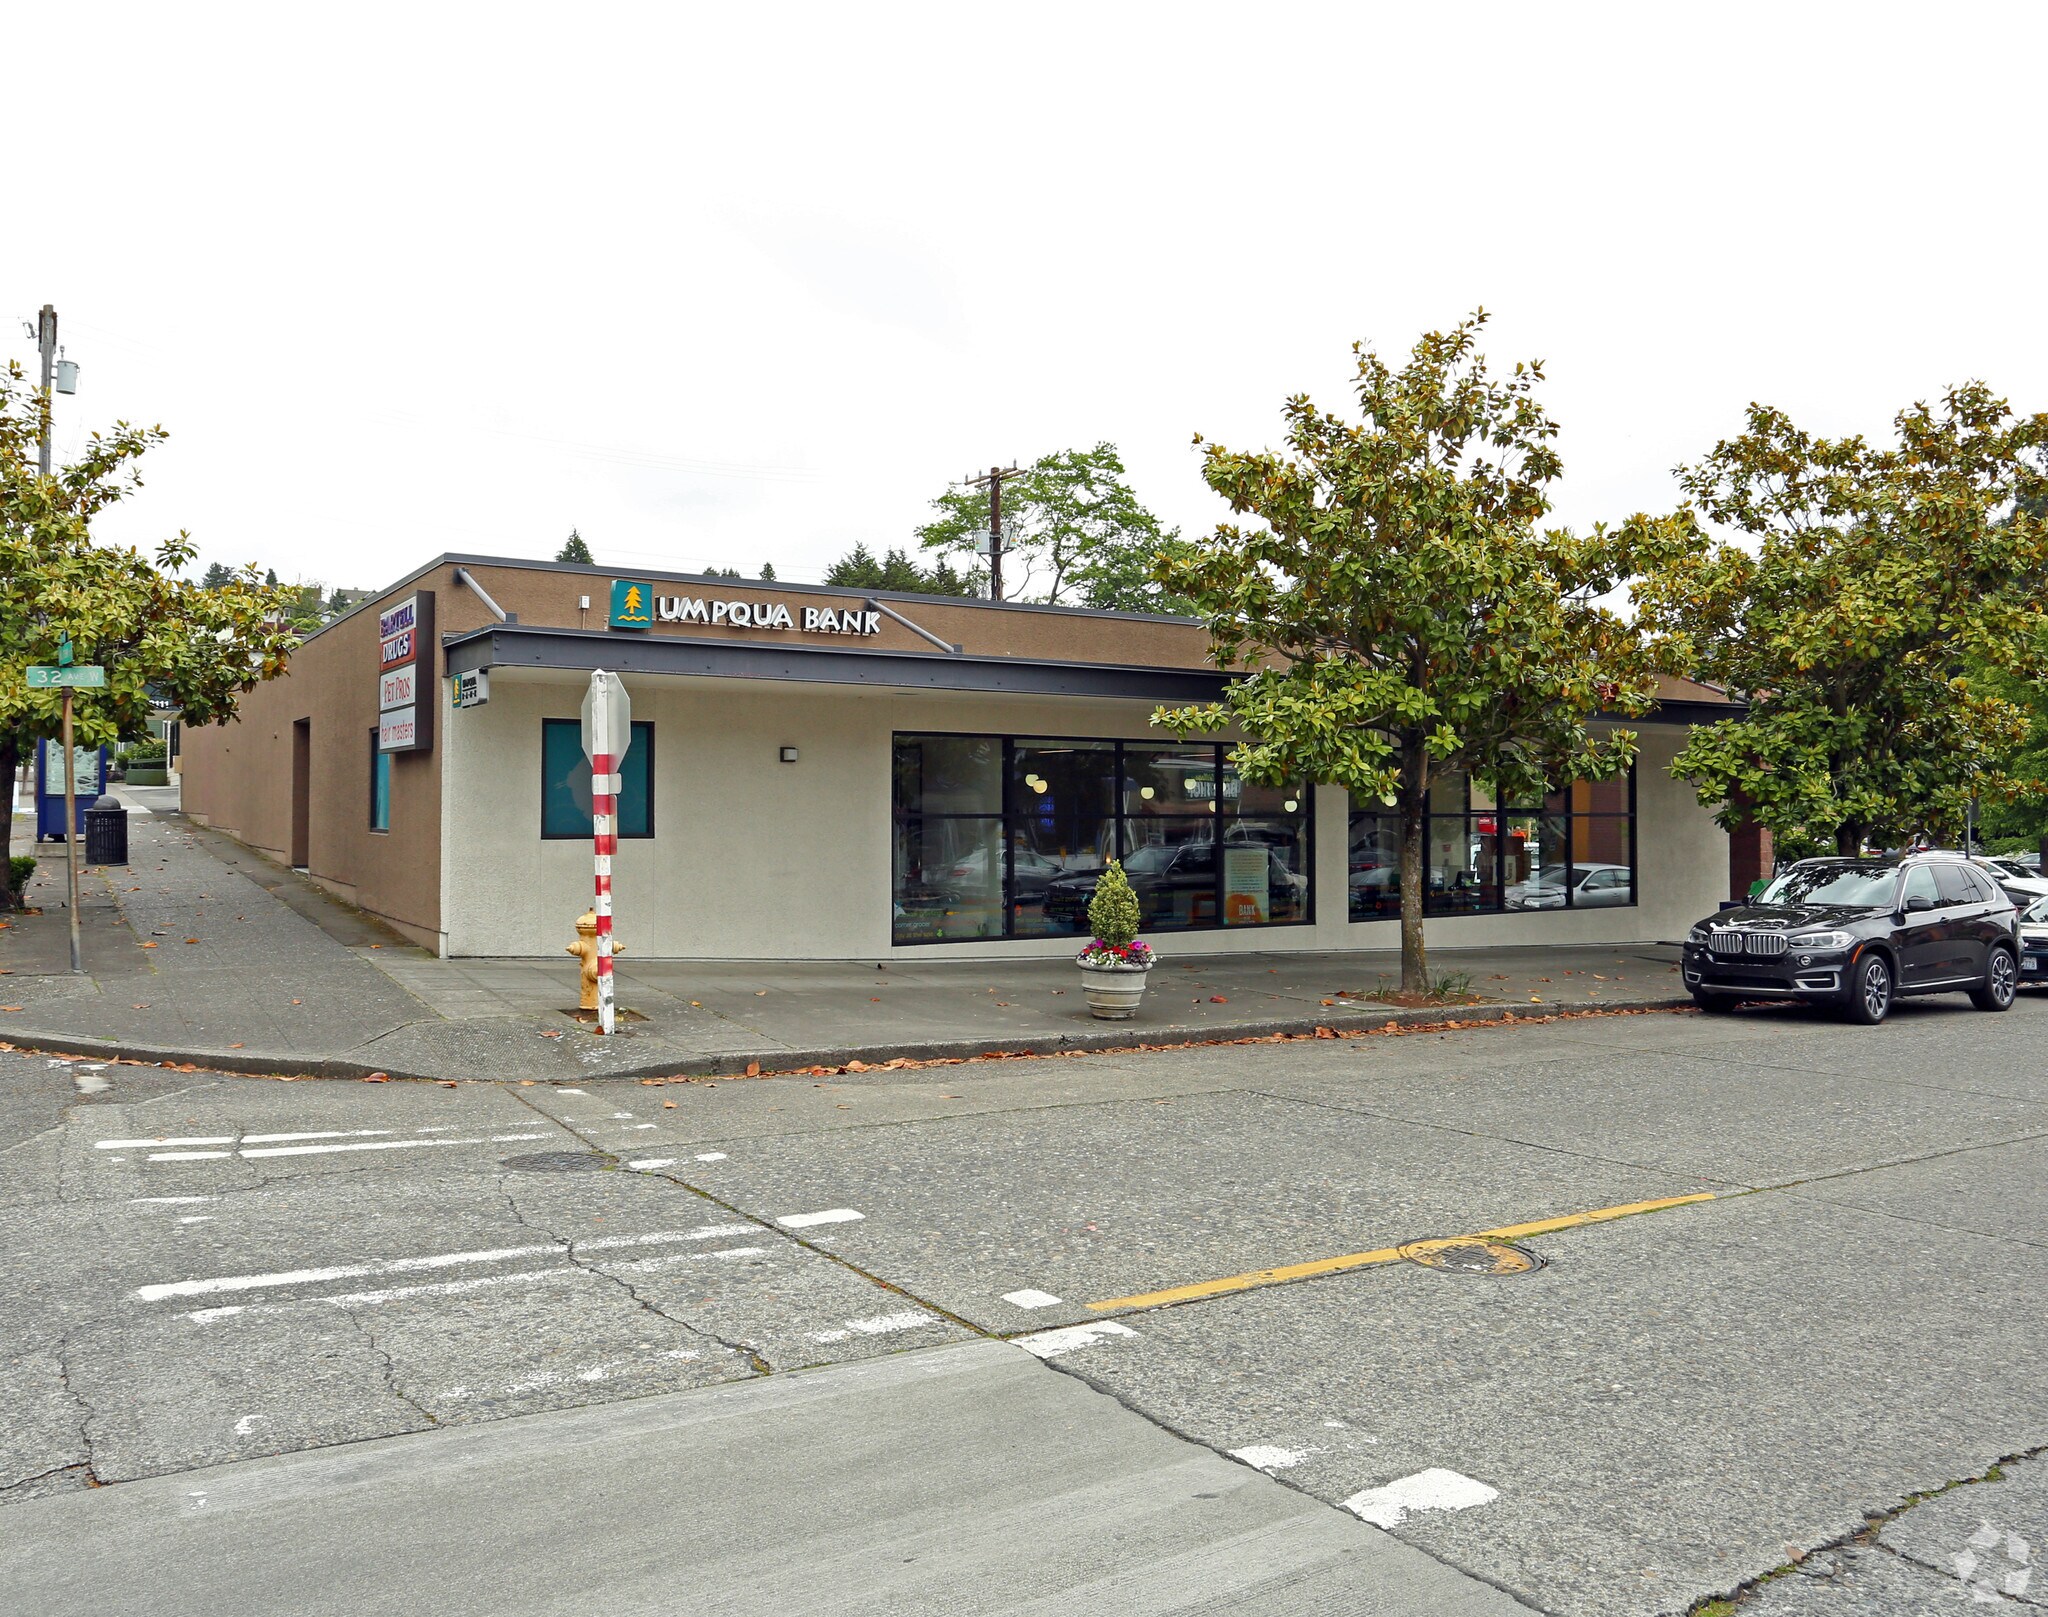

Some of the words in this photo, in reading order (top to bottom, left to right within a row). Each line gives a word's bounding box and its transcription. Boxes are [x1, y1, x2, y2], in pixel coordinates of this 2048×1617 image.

[656, 596, 793, 628] UMPQUA
[800, 606, 881, 636] BANK
[383, 633, 411, 663] DRUGS
[37, 670, 62, 683] 32
[392, 720, 413, 741] masters
